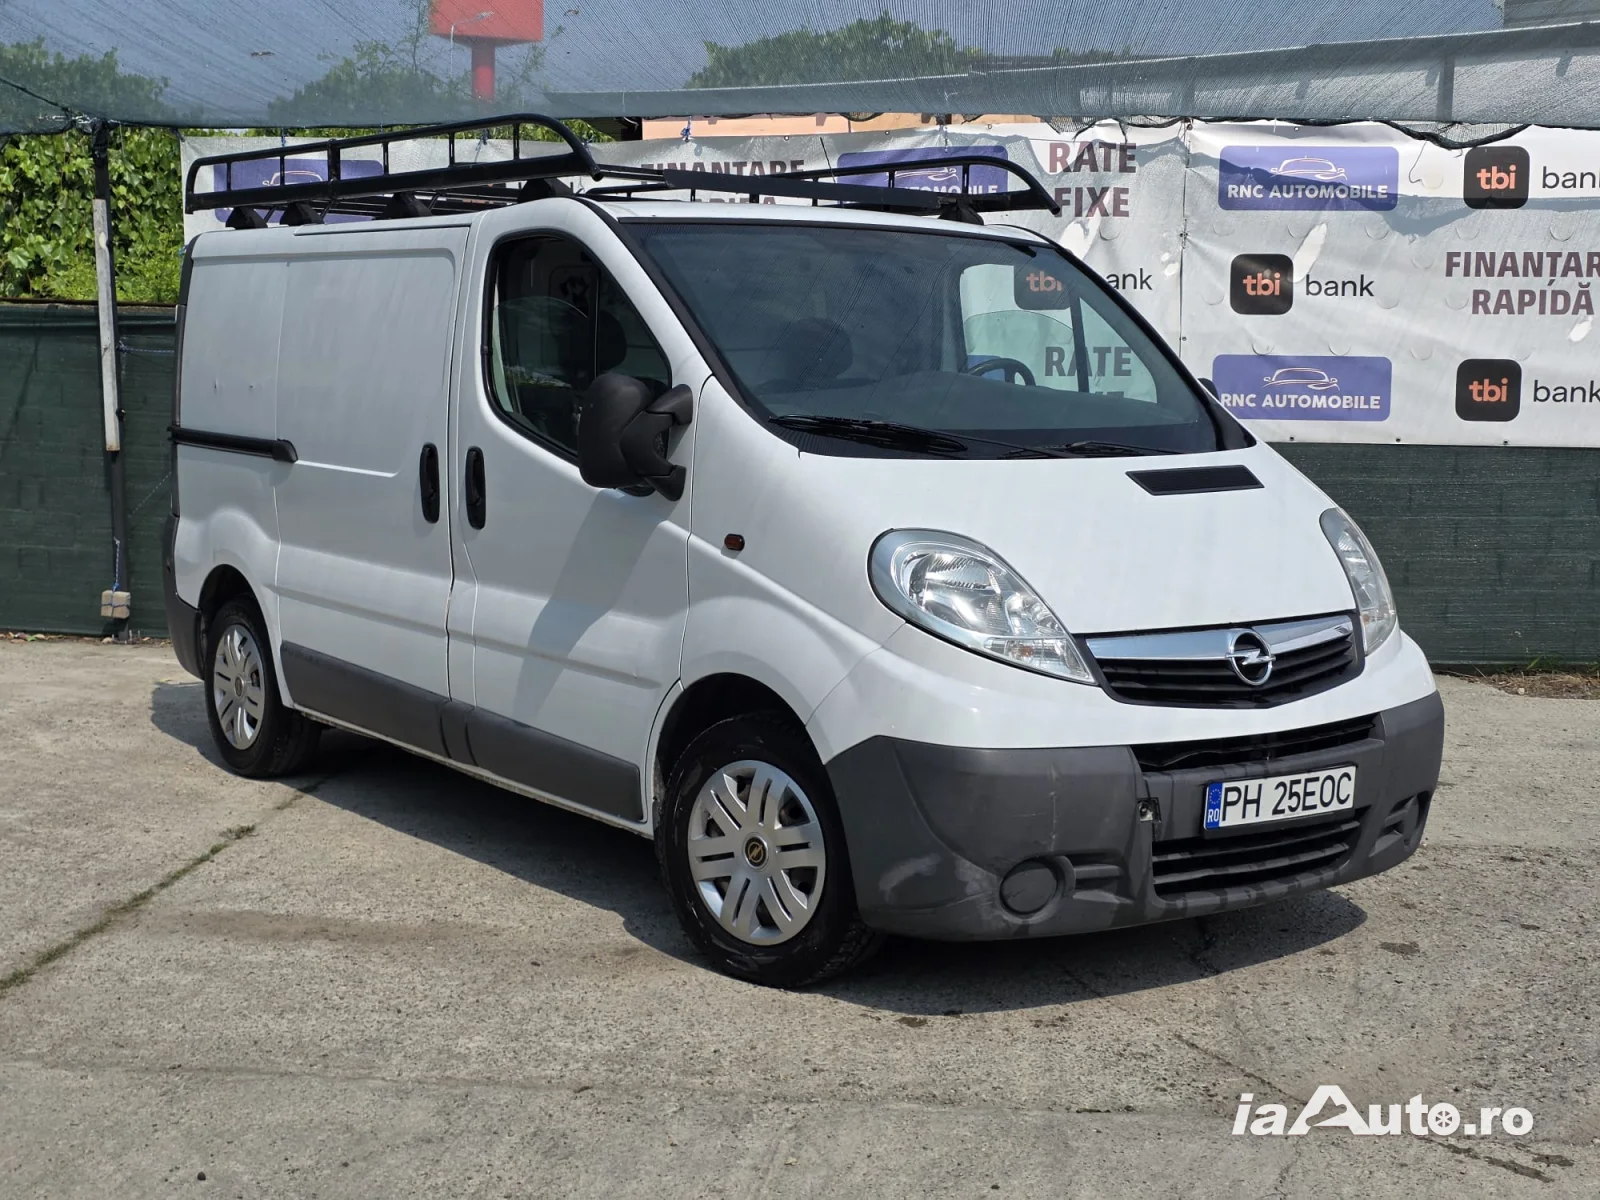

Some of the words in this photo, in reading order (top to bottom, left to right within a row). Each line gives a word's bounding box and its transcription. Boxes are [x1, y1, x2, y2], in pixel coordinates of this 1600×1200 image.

[1049, 141, 1137, 173] RATE
[1476, 164, 1517, 190] tbi
[1542, 165, 1600, 189] ban
[1054, 187, 1130, 217] FIXE
[1228, 184, 1264, 199] RNC
[1269, 185, 1388, 199] AUTOMOBILE
[1243, 272, 1281, 296] tbi
[1305, 274, 1375, 297] bank
[1221, 393, 1257, 408] RNC
[1261, 394, 1381, 409] AUTOMOBILE
[1468, 377, 1508, 402] tbi
[1533, 379, 1600, 403] bank
[1221, 783, 1262, 822] PH
[1271, 772, 1352, 816] 25EOC
[1207, 808, 1220, 824] RO
